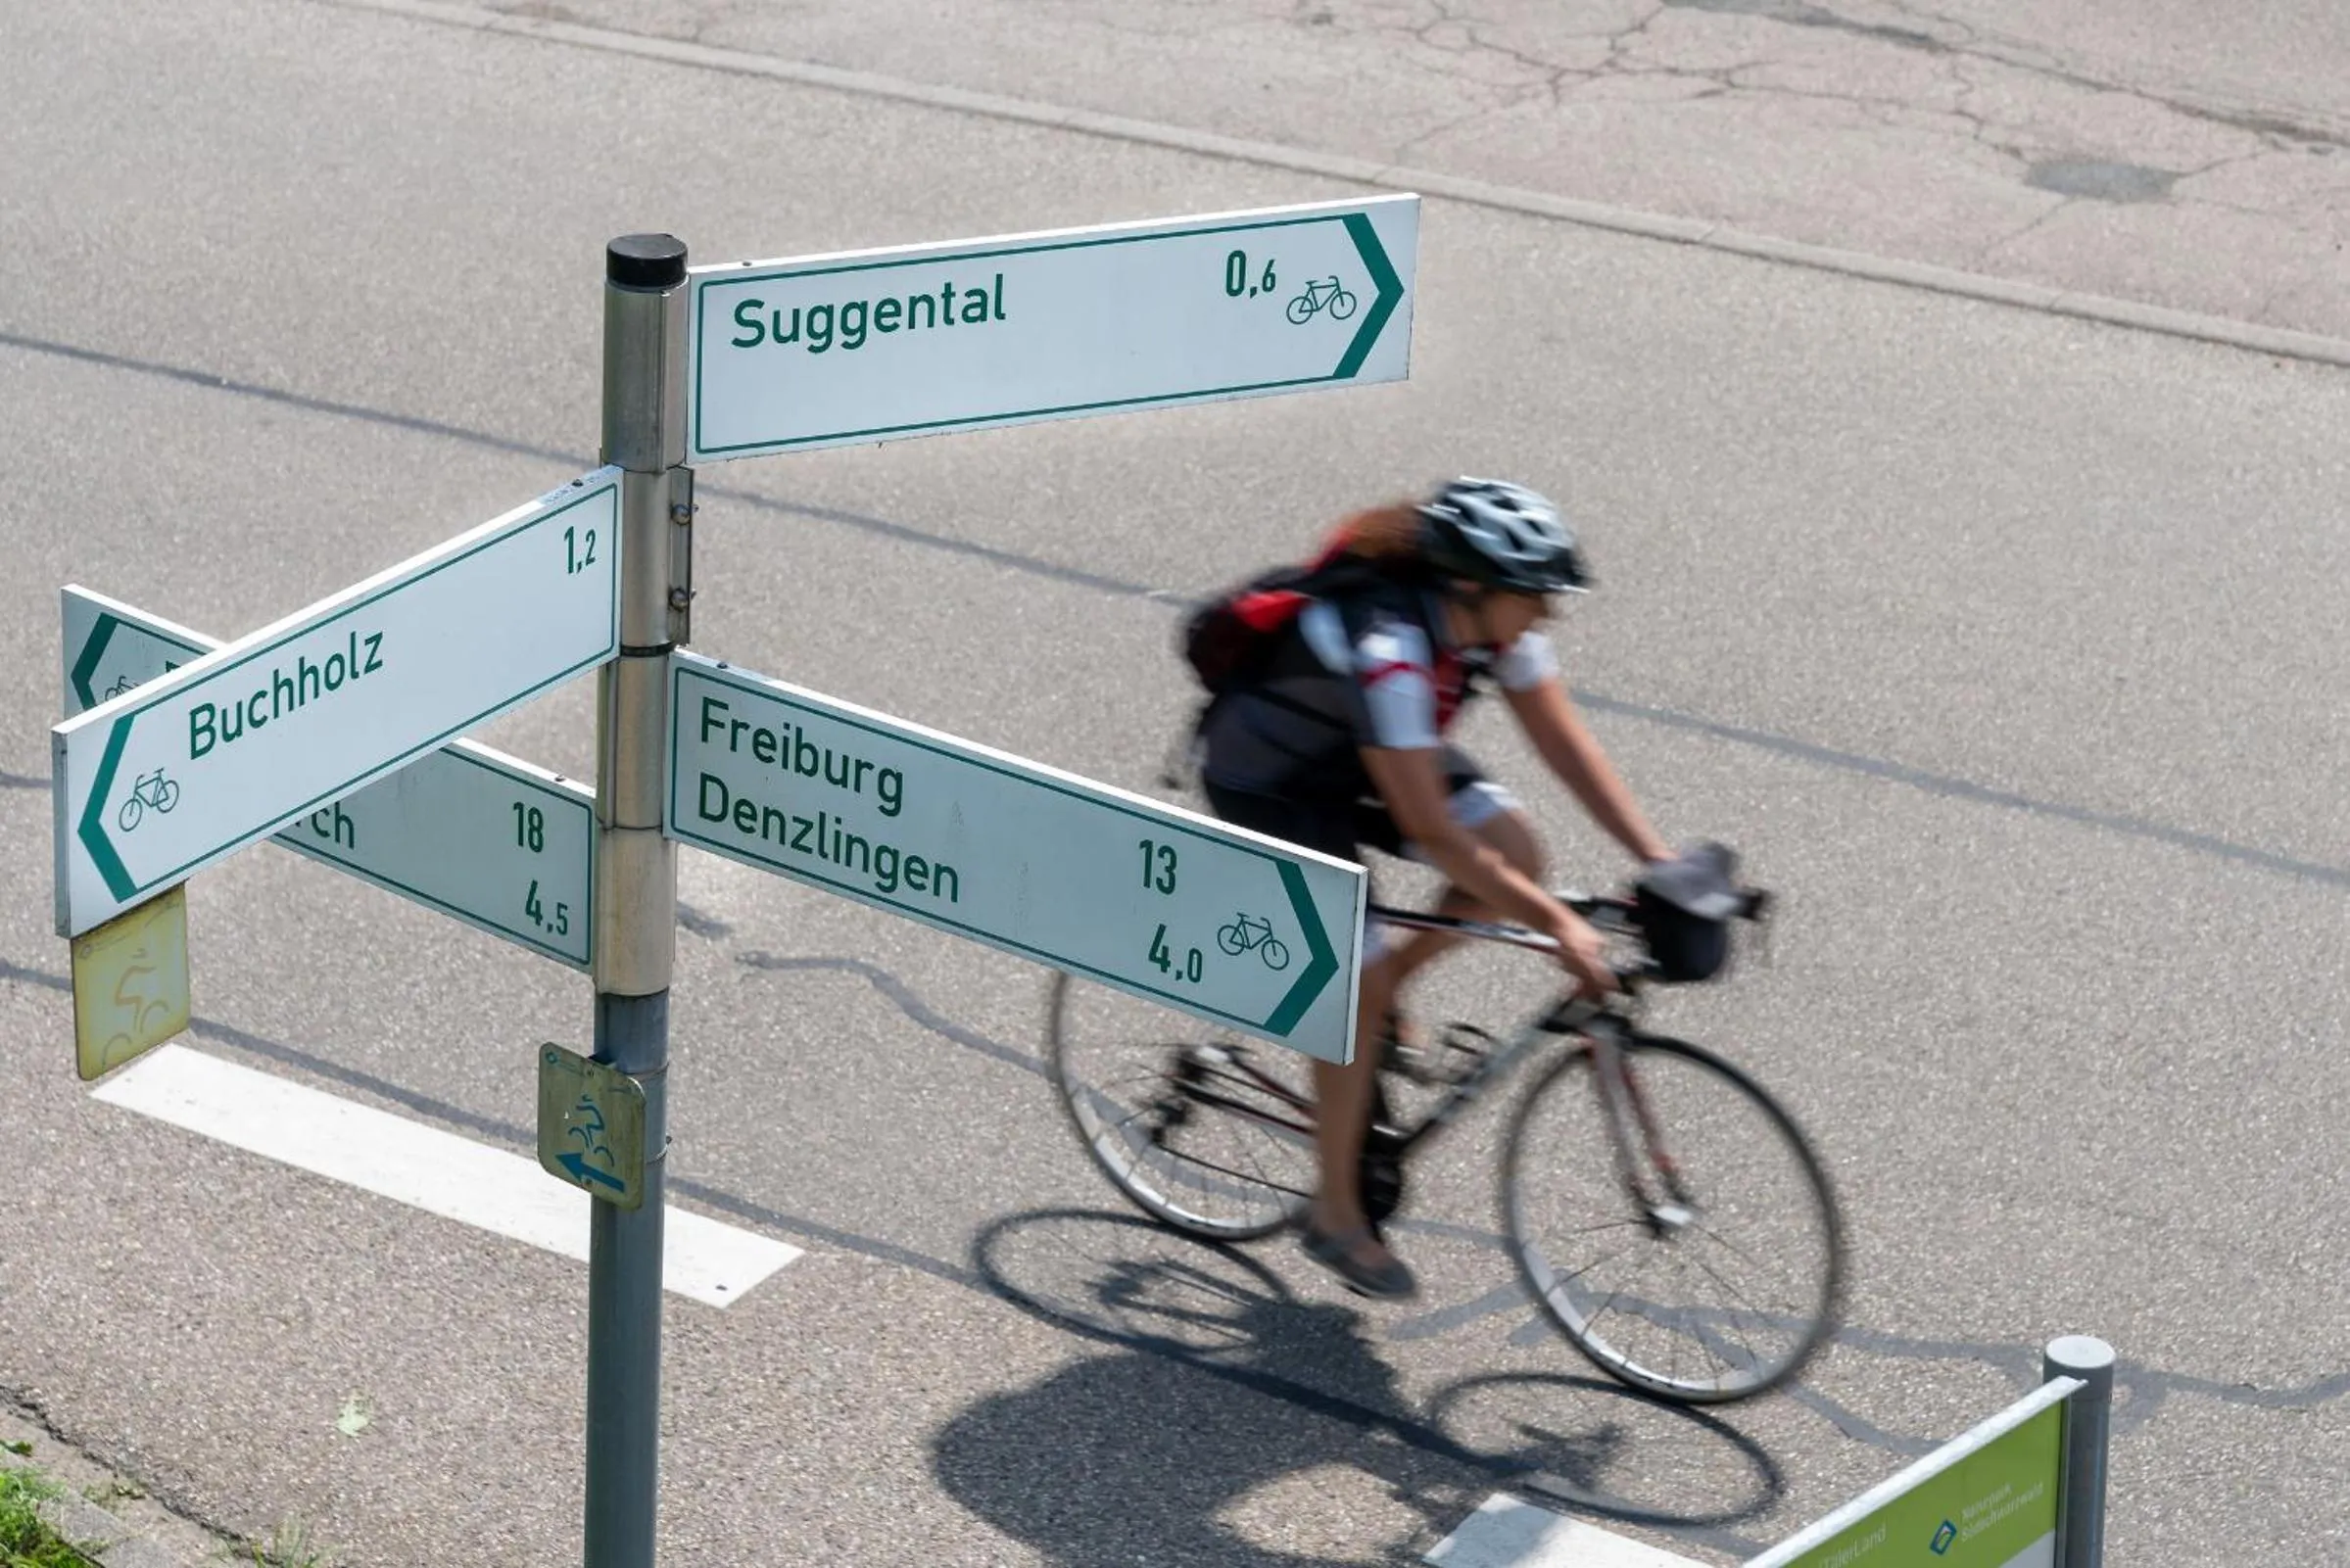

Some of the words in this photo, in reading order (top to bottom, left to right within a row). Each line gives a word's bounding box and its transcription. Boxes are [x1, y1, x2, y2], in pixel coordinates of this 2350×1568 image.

[731, 273, 1006, 355] Suggental
[1225, 250, 1276, 299] 0,6
[190, 631, 384, 761] Buchholz
[563, 525, 597, 575] 1,2
[512, 801, 545, 853] 18
[700, 695, 903, 818] Freiburg
[1138, 838, 1177, 895] 13
[524, 879, 568, 936] 4,5
[698, 772, 959, 904] Denzlingen
[1148, 923, 1203, 983] 4,0
